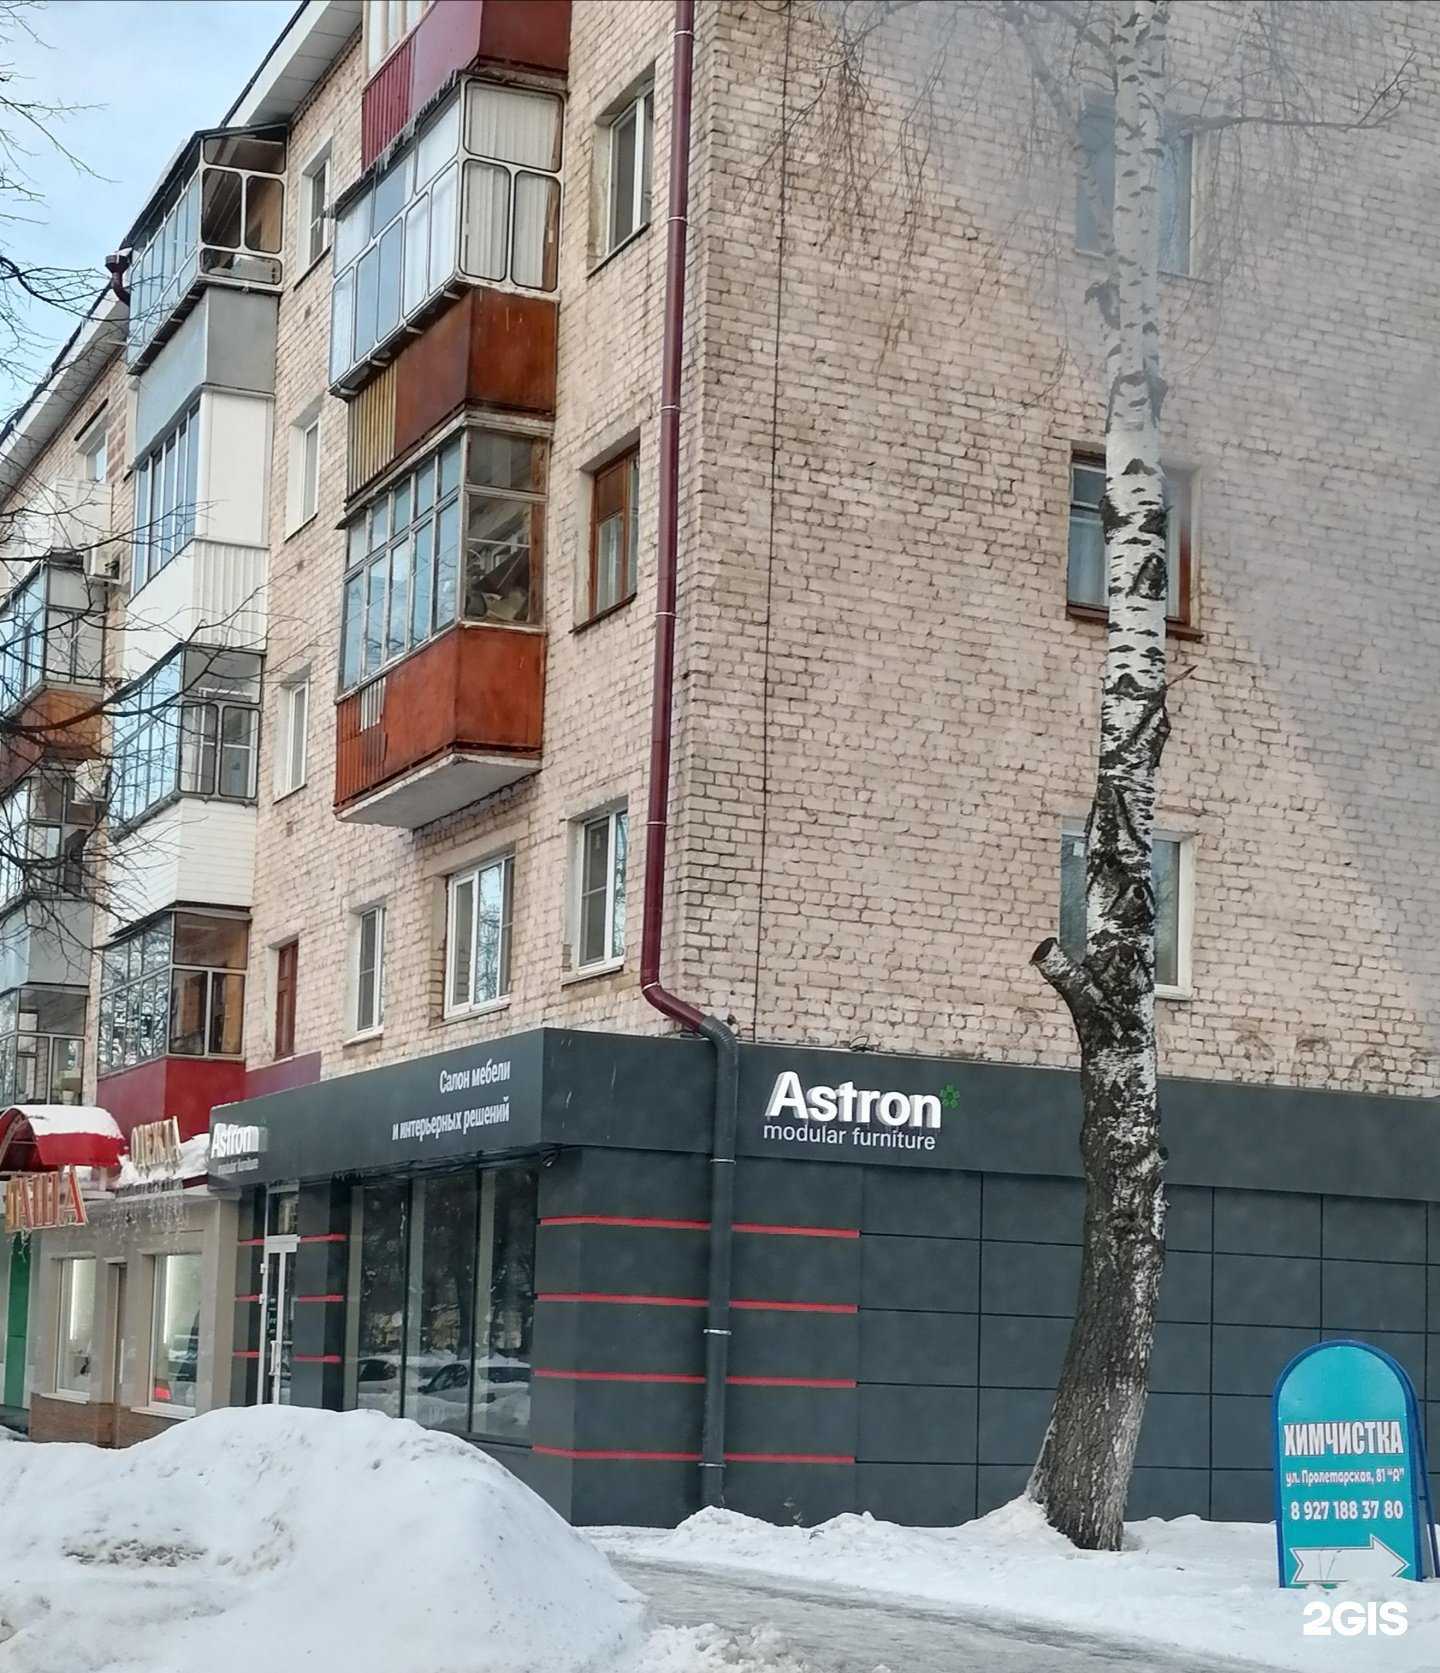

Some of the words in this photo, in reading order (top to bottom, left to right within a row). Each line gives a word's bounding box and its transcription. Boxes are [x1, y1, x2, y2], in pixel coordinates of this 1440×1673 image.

[439, 1069, 470, 1094] Салон
[472, 1058, 511, 1087] мебели
[764, 1070, 942, 1129] Astron
[391, 1123, 399, 1140] и
[400, 1111, 462, 1142] интерьерных
[463, 1096, 510, 1135] решений
[763, 1123, 847, 1145] modular
[852, 1126, 936, 1150] furniture
[211, 1122, 260, 1159] Astron
[1284, 1421, 1404, 1456] ХИМЧИСТКА
[1375, 1468, 1385, 1482] 81
[1290, 1501, 1300, 1520] 8
[1304, 1501, 1329, 1520] 927
[1333, 1501, 1358, 1519] 188
[1362, 1500, 1379, 1519] 37
[1384, 1500, 1404, 1519] 80
